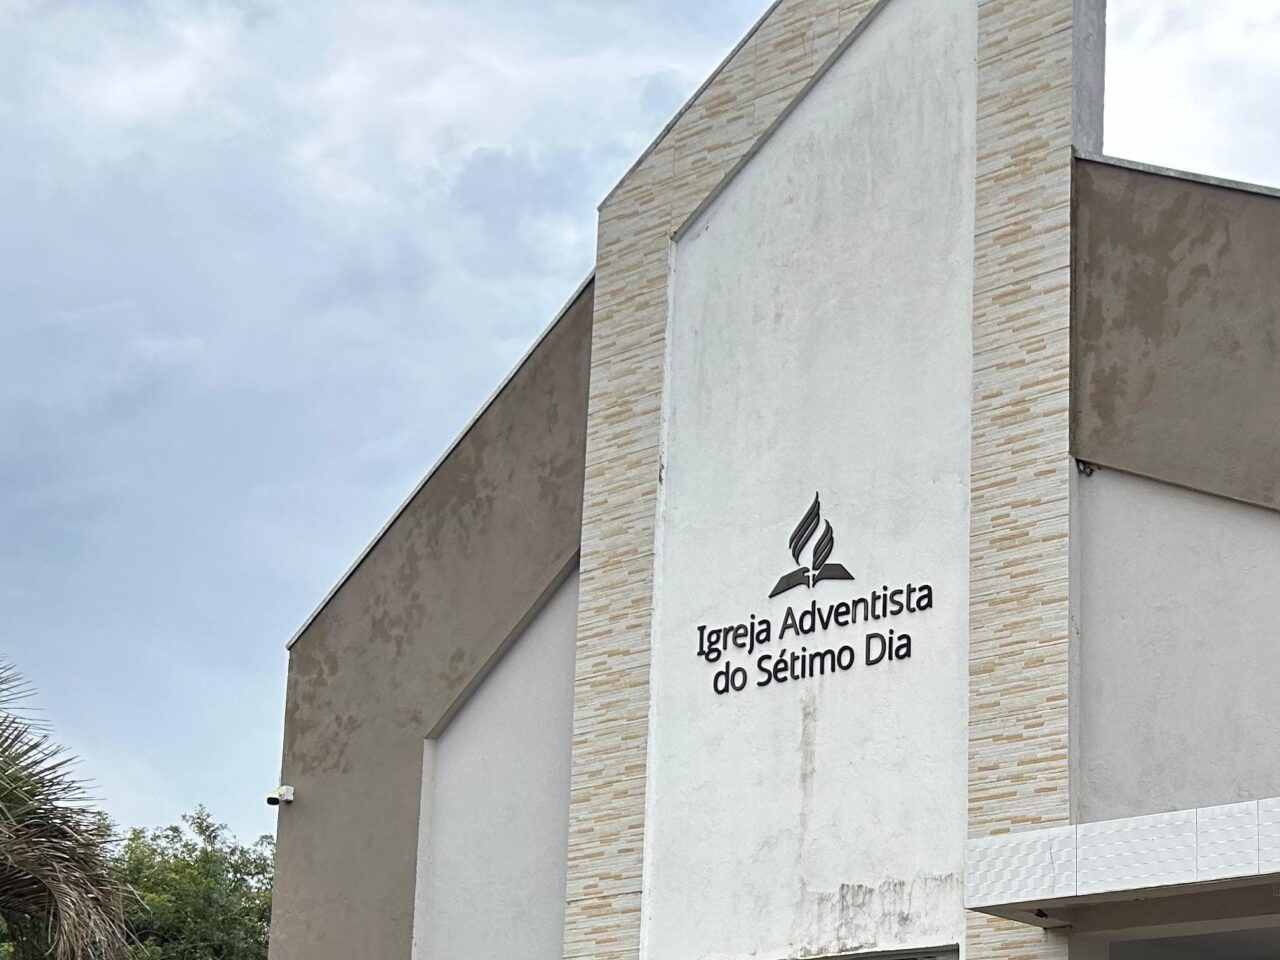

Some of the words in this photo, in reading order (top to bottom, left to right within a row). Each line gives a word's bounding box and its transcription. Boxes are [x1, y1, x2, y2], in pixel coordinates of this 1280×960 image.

[697, 614, 771, 663] Igreja
[778, 583, 933, 639] Adventista
[713, 661, 747, 694] do
[756, 648, 855, 687] Sétimo
[865, 629, 912, 665] Dia
